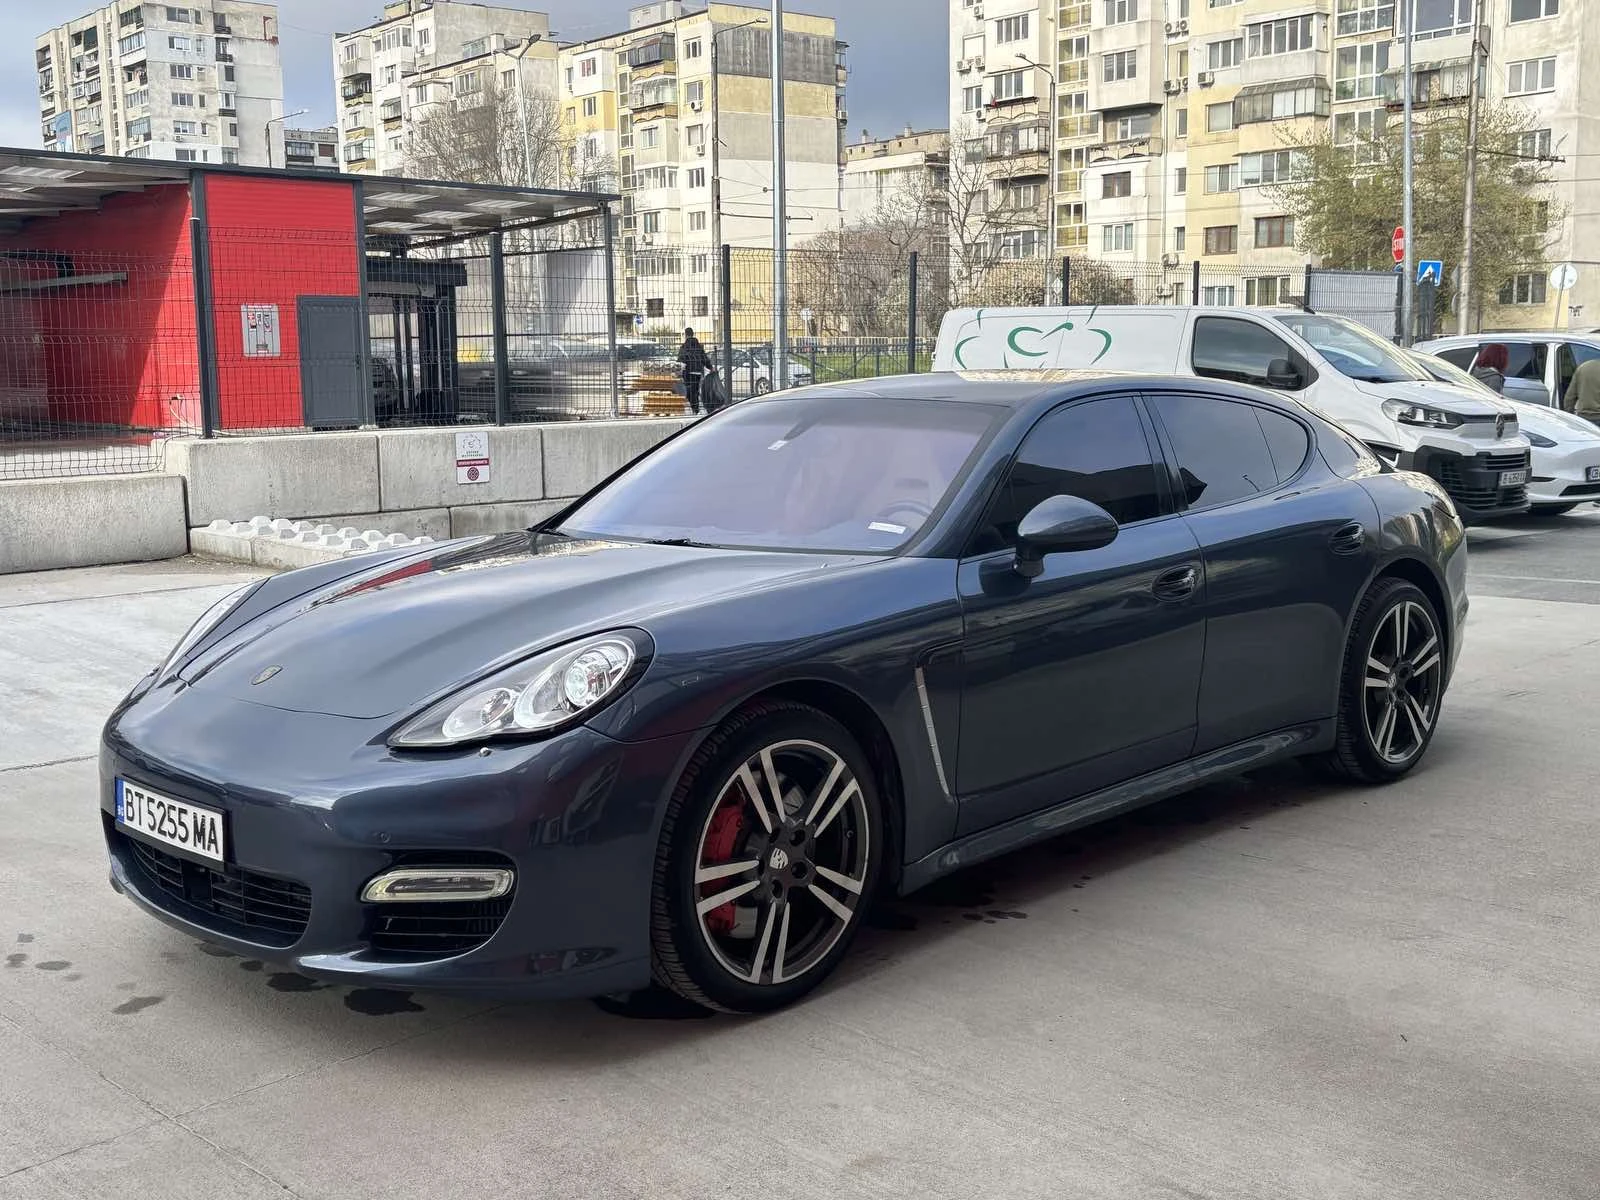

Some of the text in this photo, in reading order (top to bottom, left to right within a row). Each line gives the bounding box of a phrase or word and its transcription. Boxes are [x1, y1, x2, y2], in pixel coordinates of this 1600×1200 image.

[1393, 238, 1404, 251] STO
[125, 788, 219, 854] BT 5255 MA
